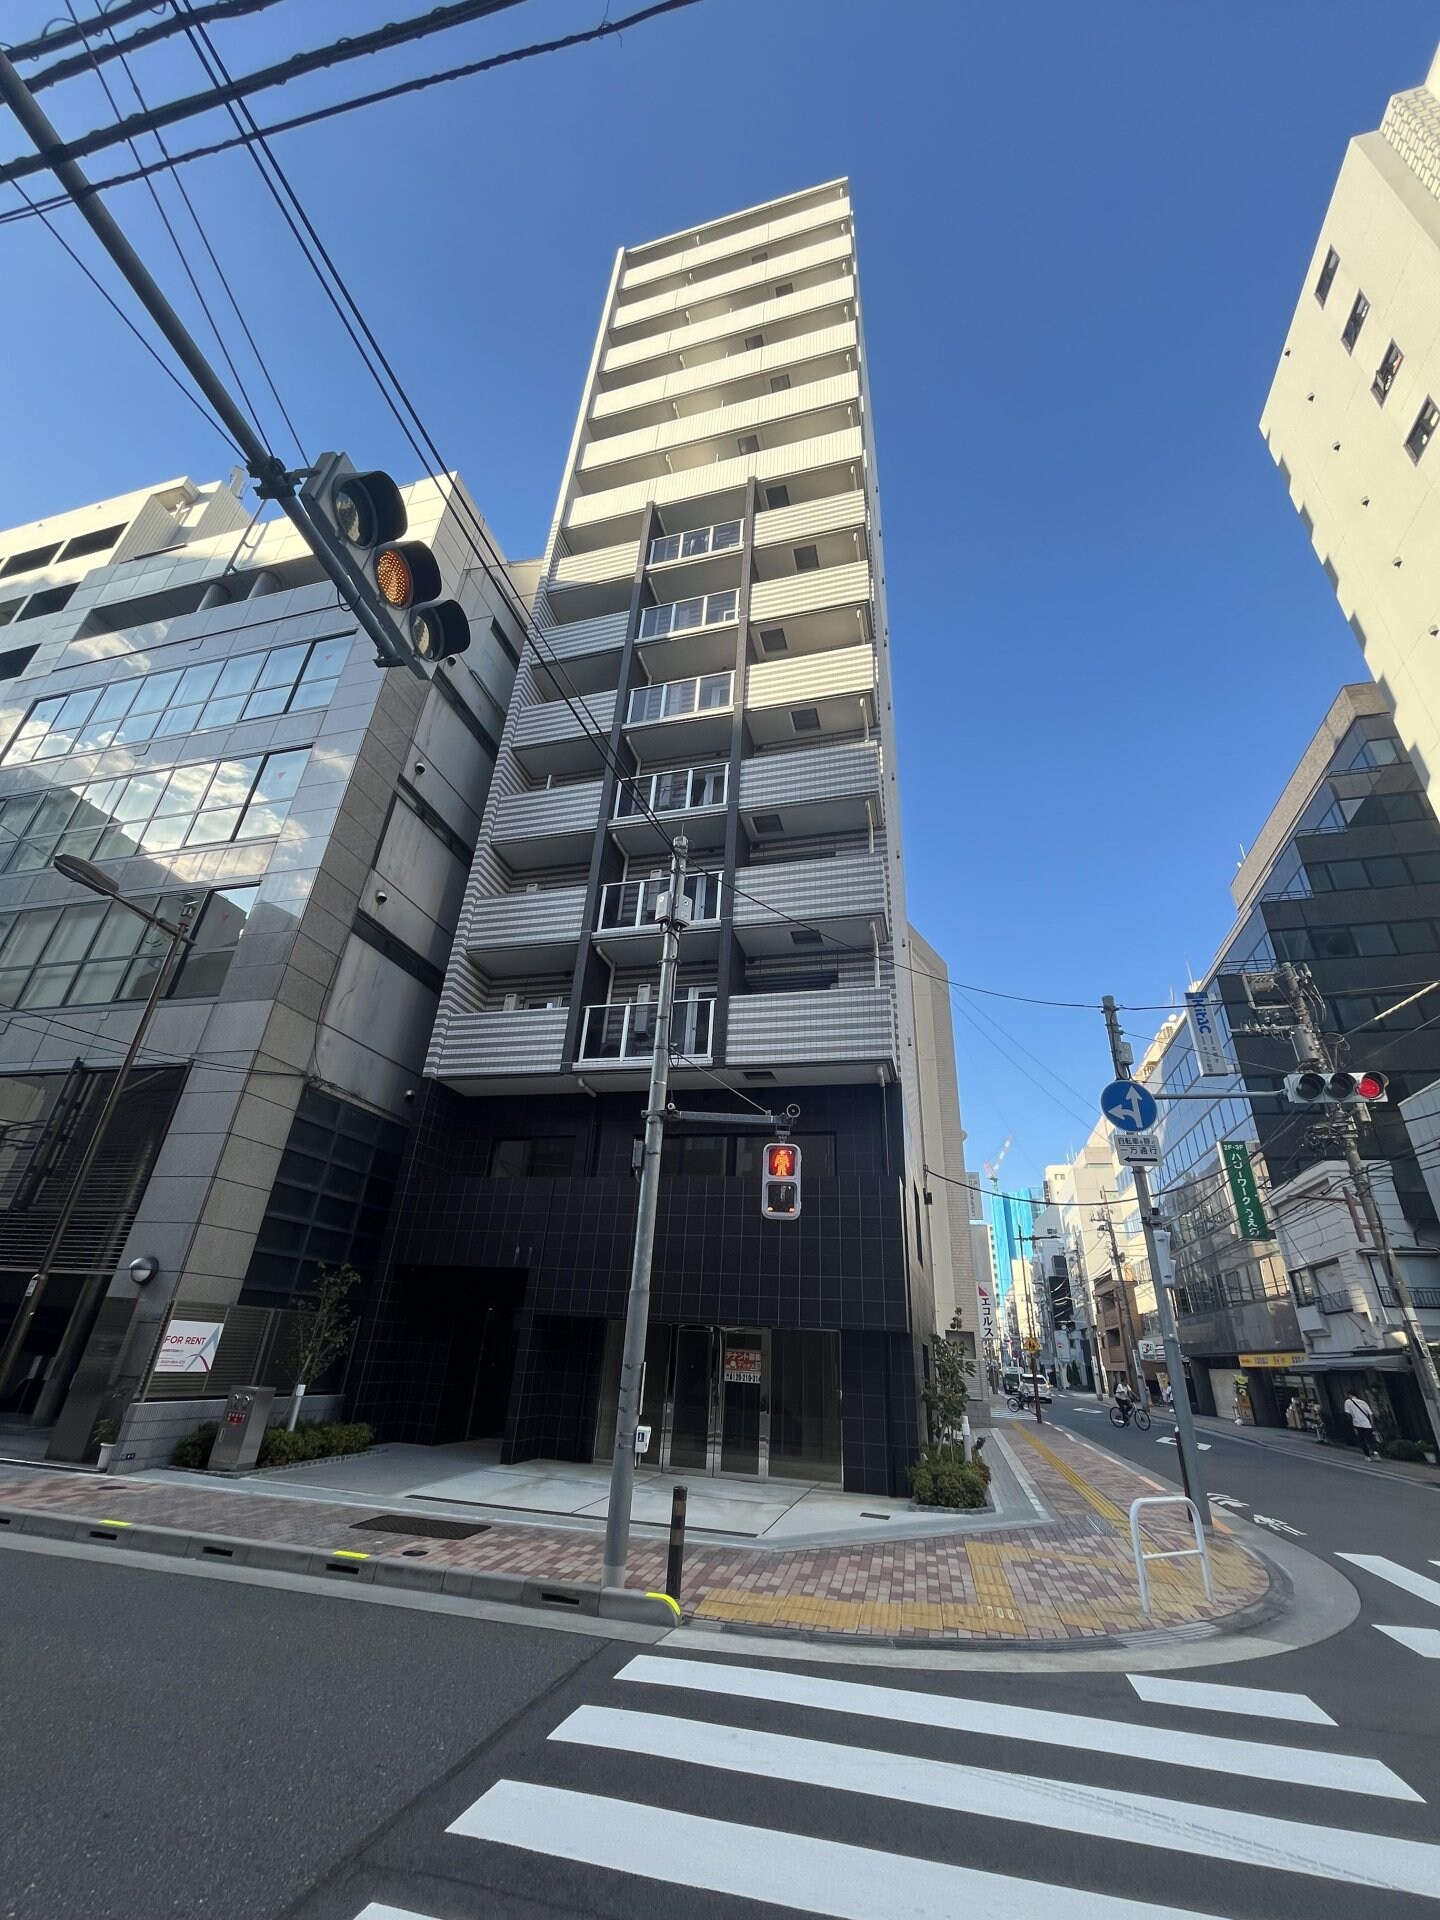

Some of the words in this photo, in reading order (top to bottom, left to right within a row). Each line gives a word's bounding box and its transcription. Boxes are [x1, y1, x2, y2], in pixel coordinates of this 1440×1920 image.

[1120, 1146, 1157, 1155] 一方通行
[981, 1297, 994, 1338] エコルス
[165, 1335, 184, 1344] FOR
[184, 1336, 207, 1345] RENT
